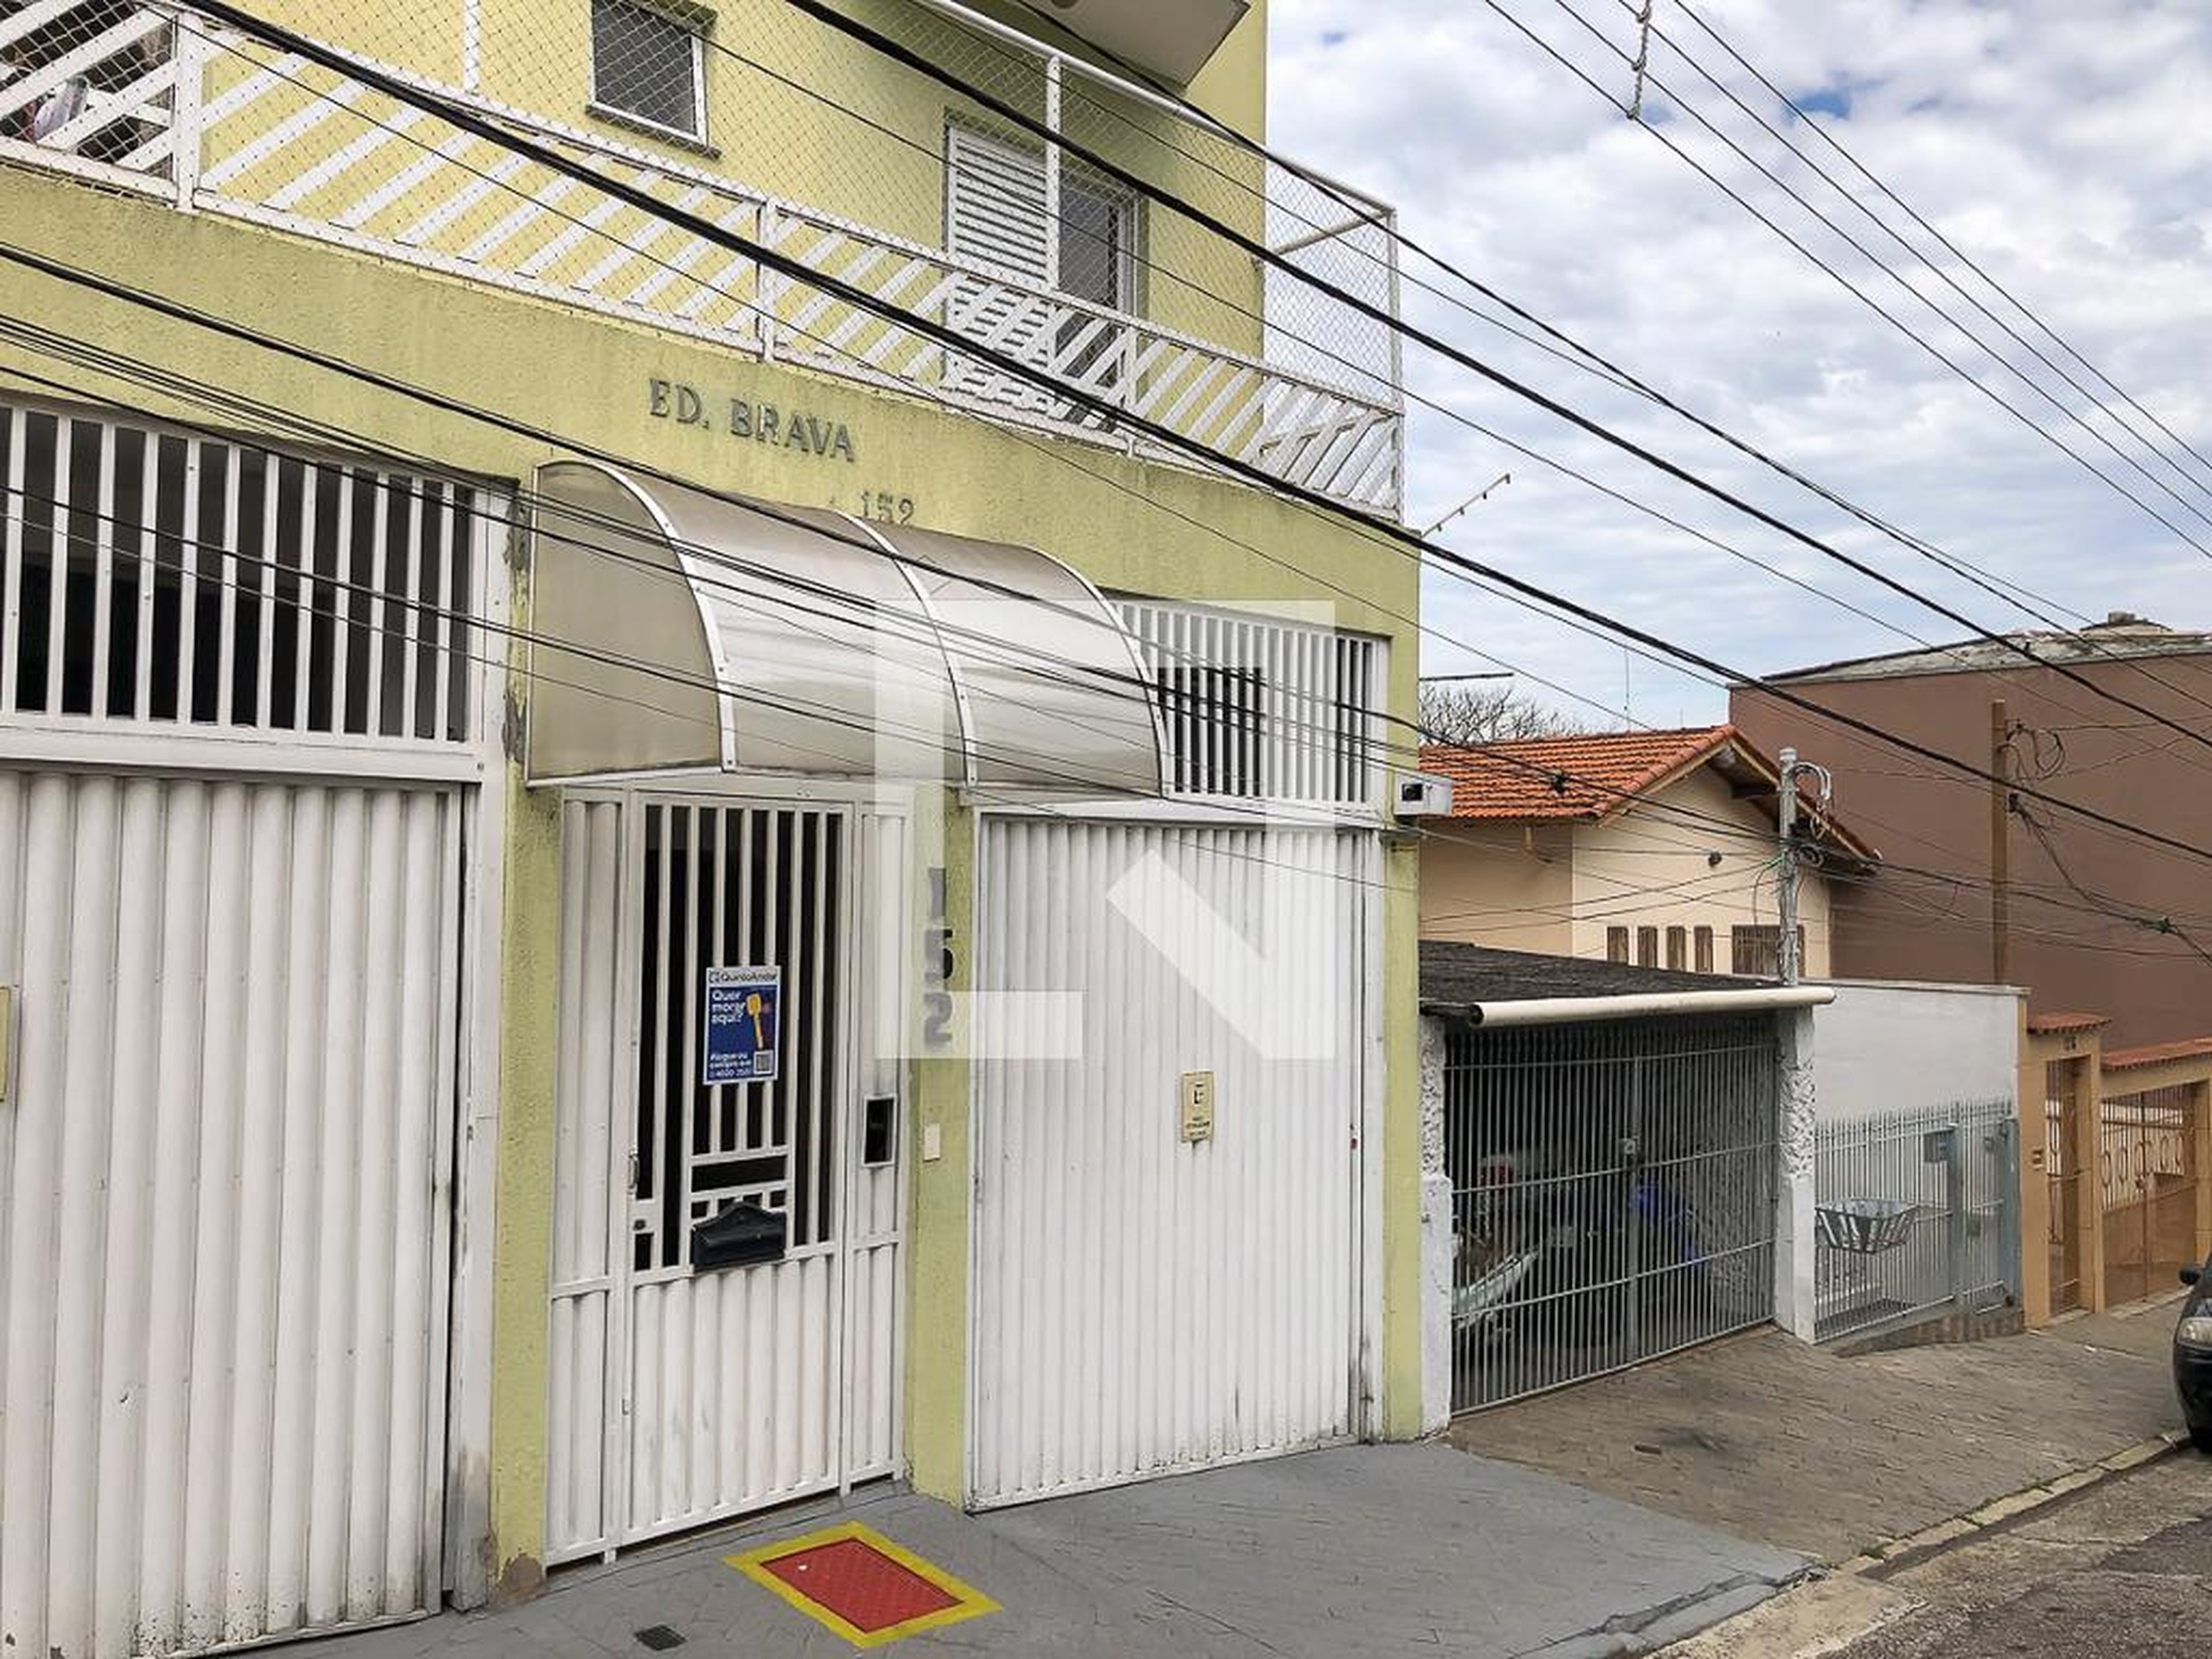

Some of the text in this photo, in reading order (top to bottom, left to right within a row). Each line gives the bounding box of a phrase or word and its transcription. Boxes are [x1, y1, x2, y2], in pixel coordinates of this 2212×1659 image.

[649, 378, 855, 463] ED. BRAVA
[861, 491, 914, 525] 152
[924, 868, 953, 1045] 152
